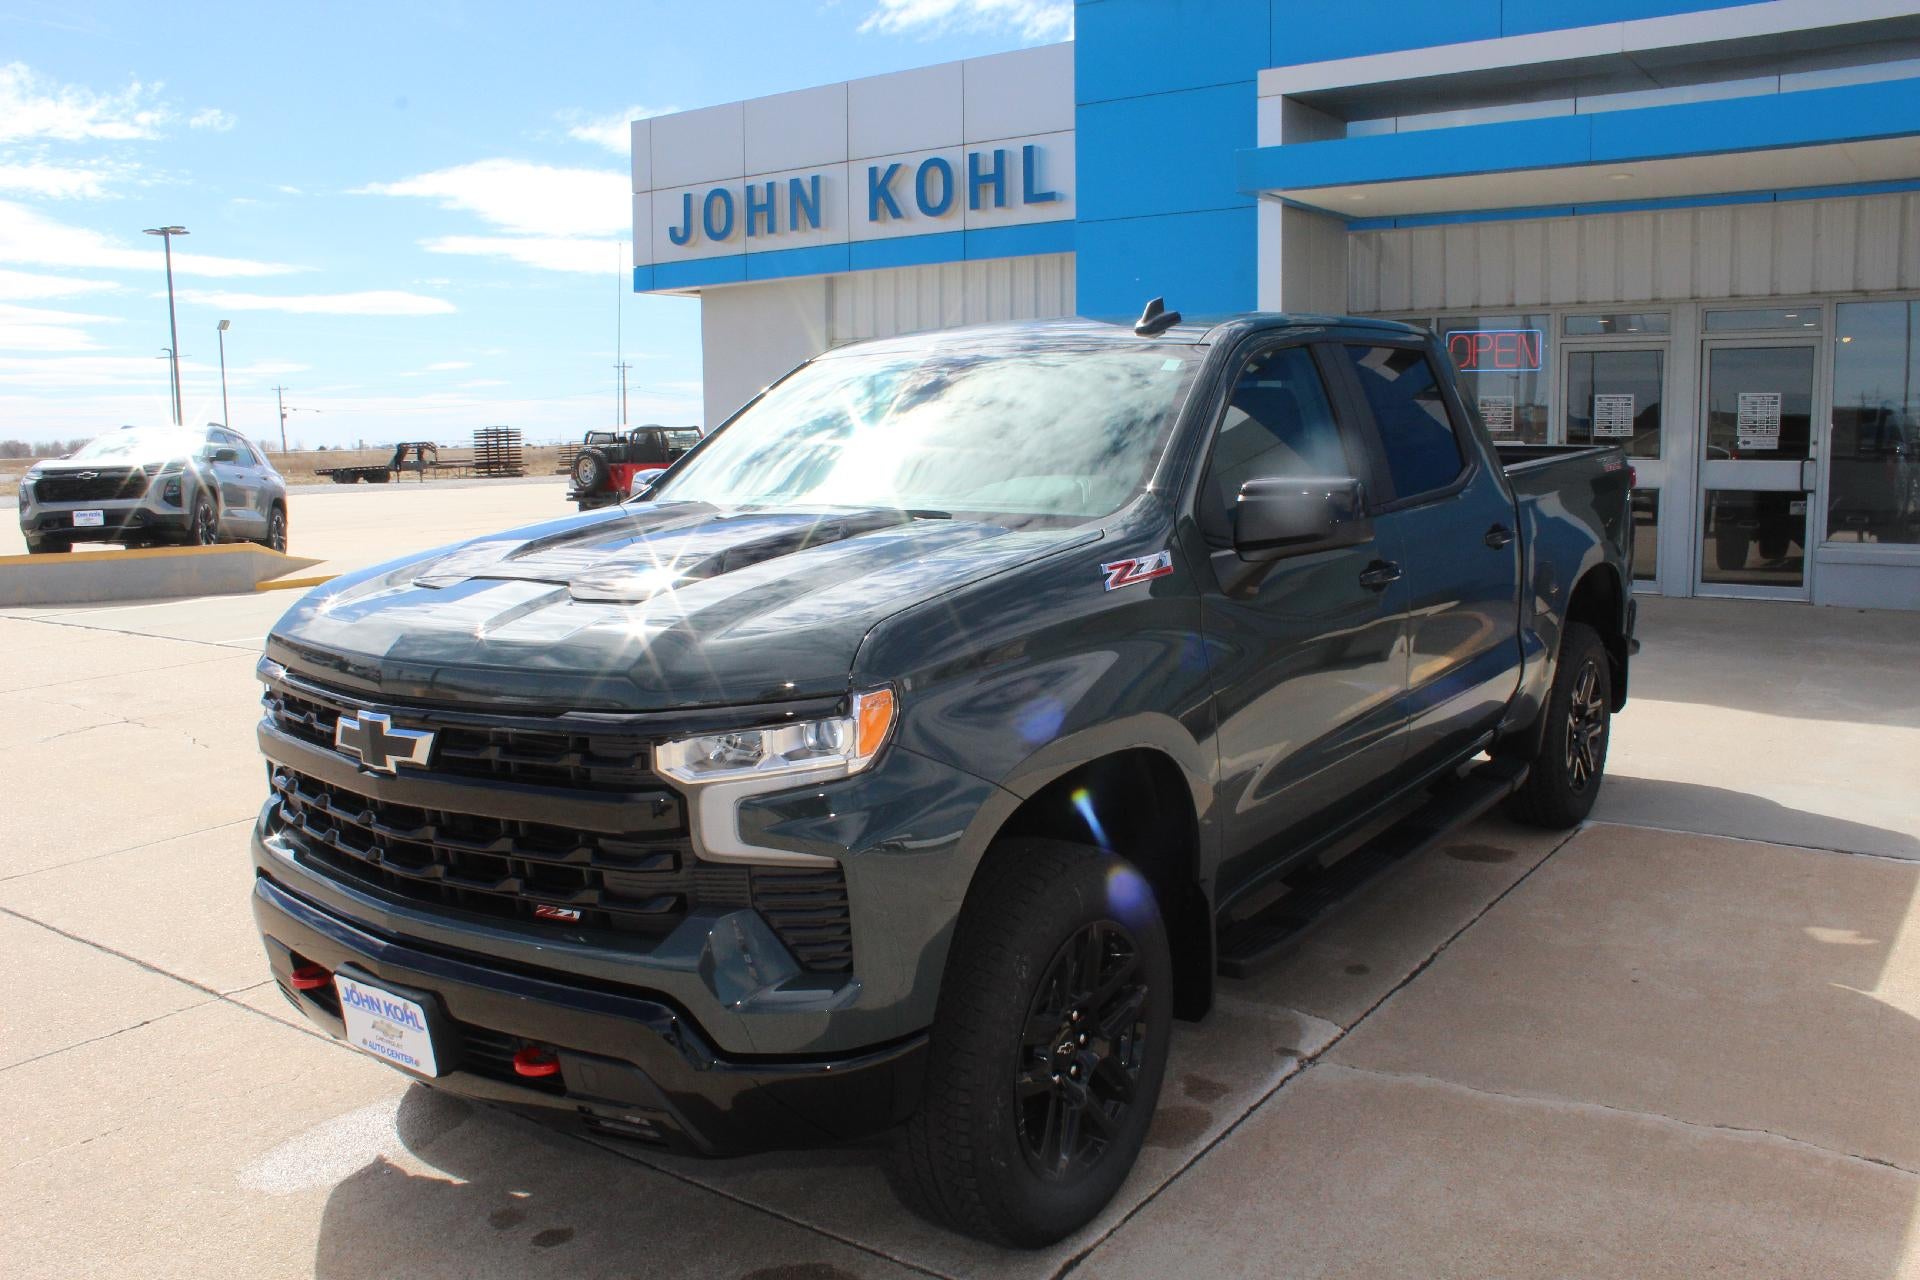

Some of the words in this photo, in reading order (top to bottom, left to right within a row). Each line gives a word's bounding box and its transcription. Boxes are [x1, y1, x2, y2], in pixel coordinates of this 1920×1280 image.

[669, 174, 821, 246] JOHN
[868, 144, 1057, 222] KOHL
[1449, 332, 1539, 369] OPEN
[1101, 549, 1174, 592] Z71
[343, 986, 382, 1014] JOHN
[384, 1000, 424, 1031] KOHL
[368, 1040, 386, 1054] AUTO
[387, 1047, 414, 1065] CENTER
